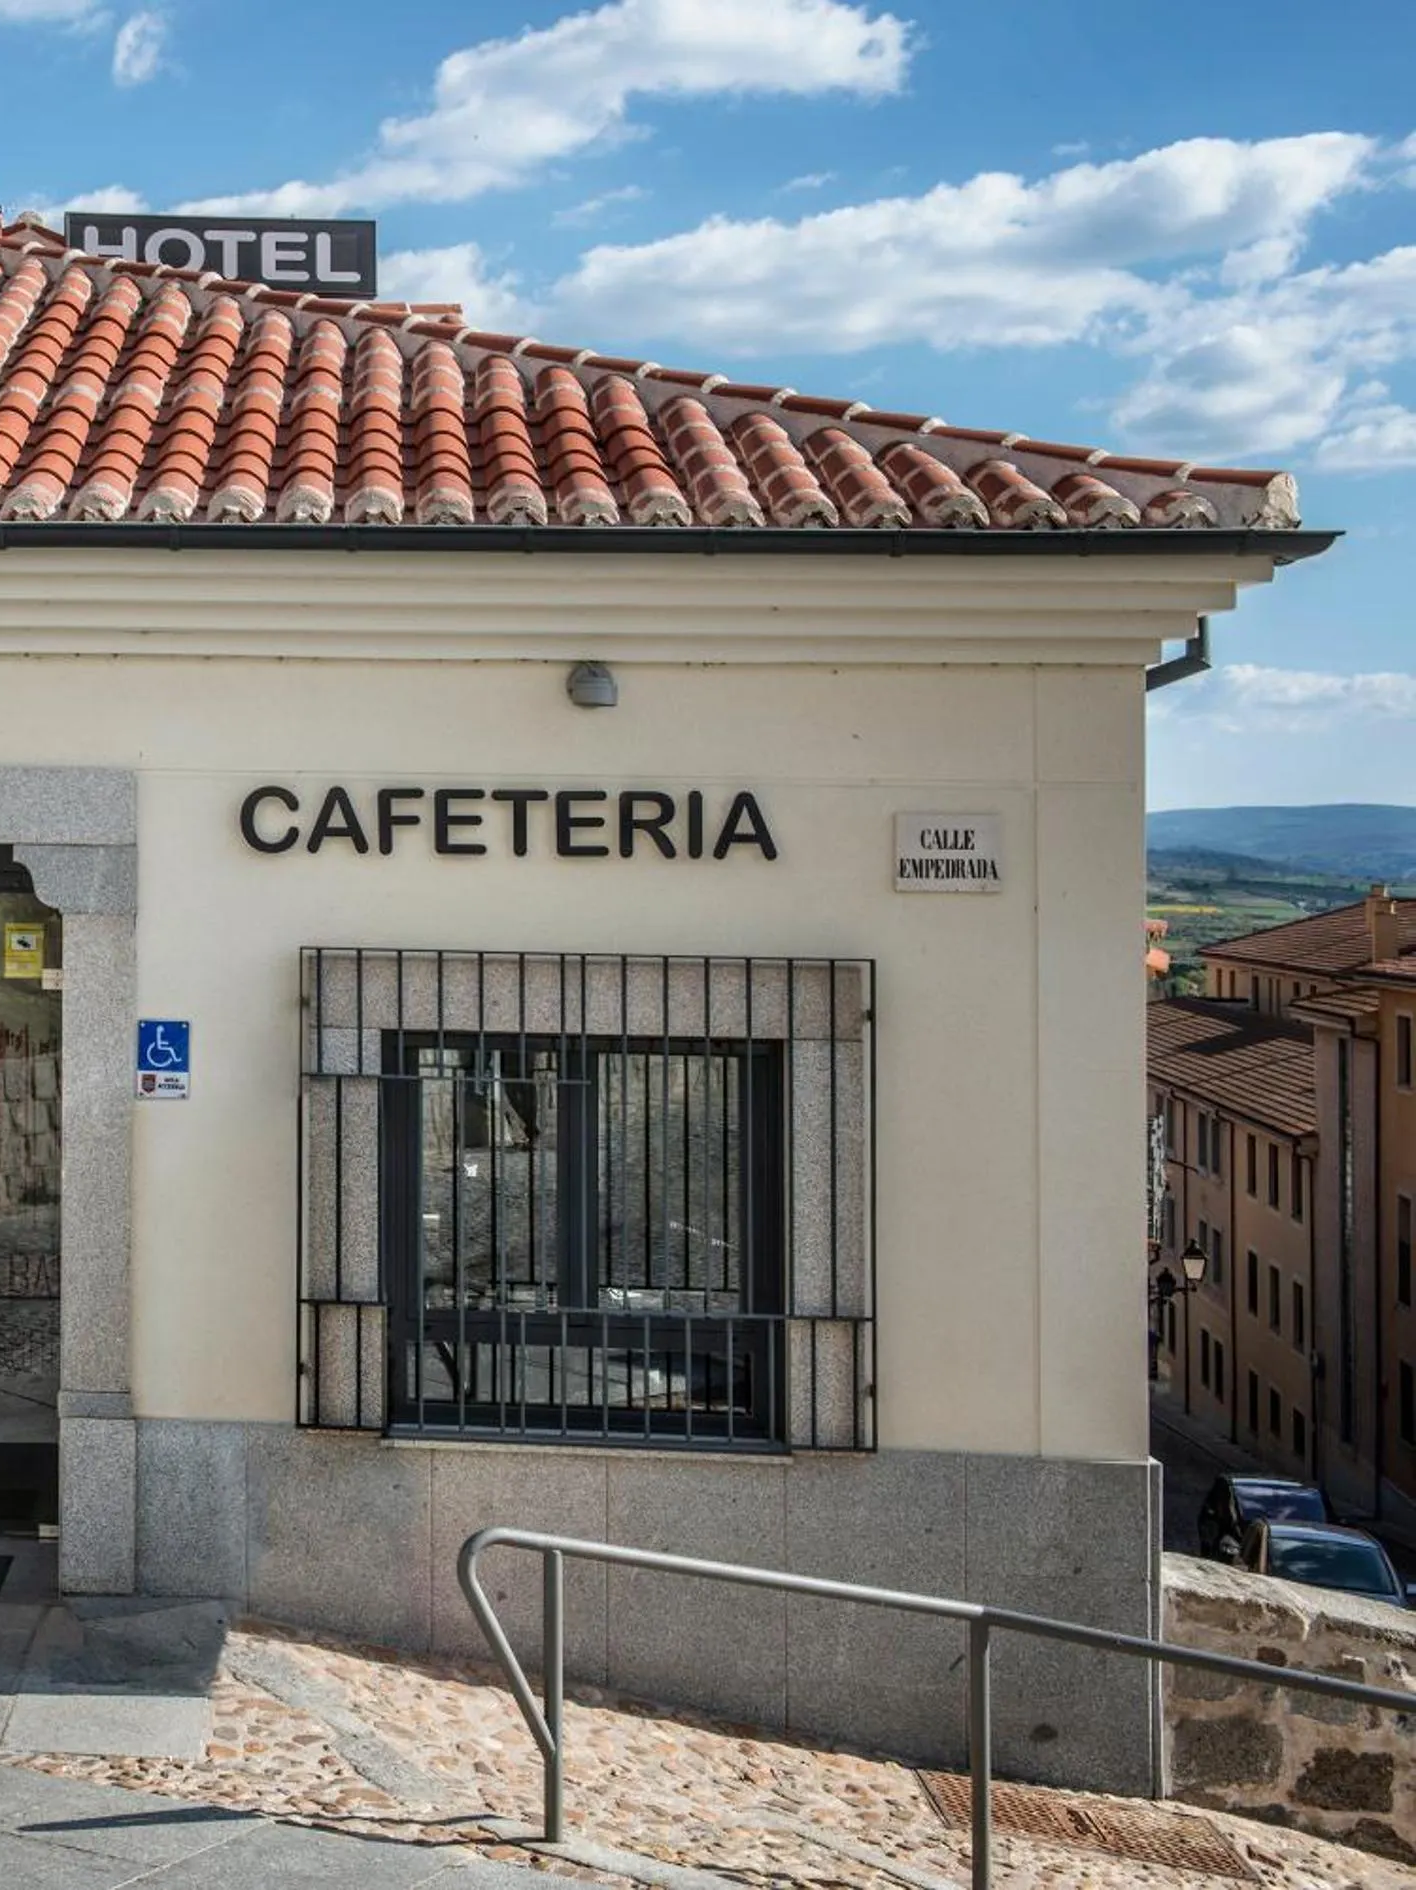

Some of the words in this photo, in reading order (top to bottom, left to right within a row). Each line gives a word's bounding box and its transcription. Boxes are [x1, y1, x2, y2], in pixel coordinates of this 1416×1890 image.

[84, 225, 361, 284] HOTEL
[240, 785, 778, 861] CAFETERIA
[920, 828, 975, 850] CALLE
[899, 858, 1000, 880] EMPEDRADA
